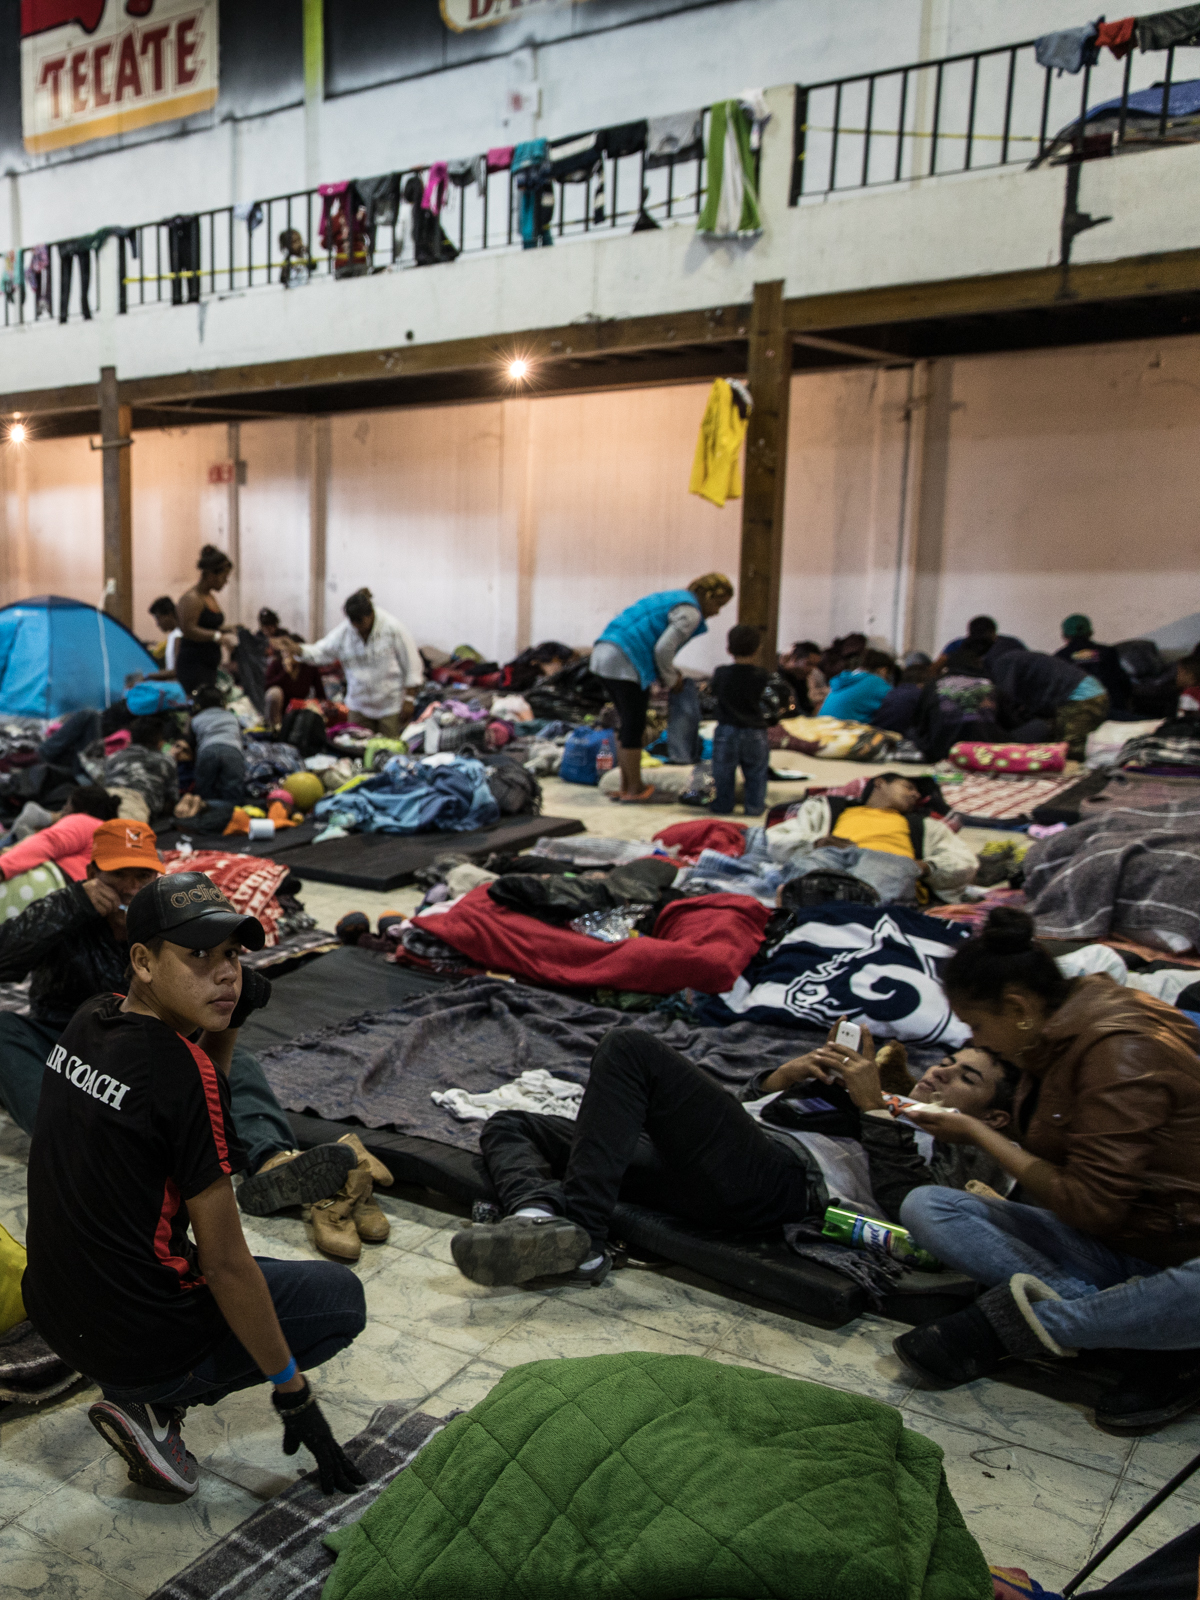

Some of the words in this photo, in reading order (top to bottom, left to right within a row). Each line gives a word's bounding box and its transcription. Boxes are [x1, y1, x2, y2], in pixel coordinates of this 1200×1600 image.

[38, 15, 202, 120] TECATE
[170, 883, 233, 909] adid
[65, 1055, 131, 1111] COACH
